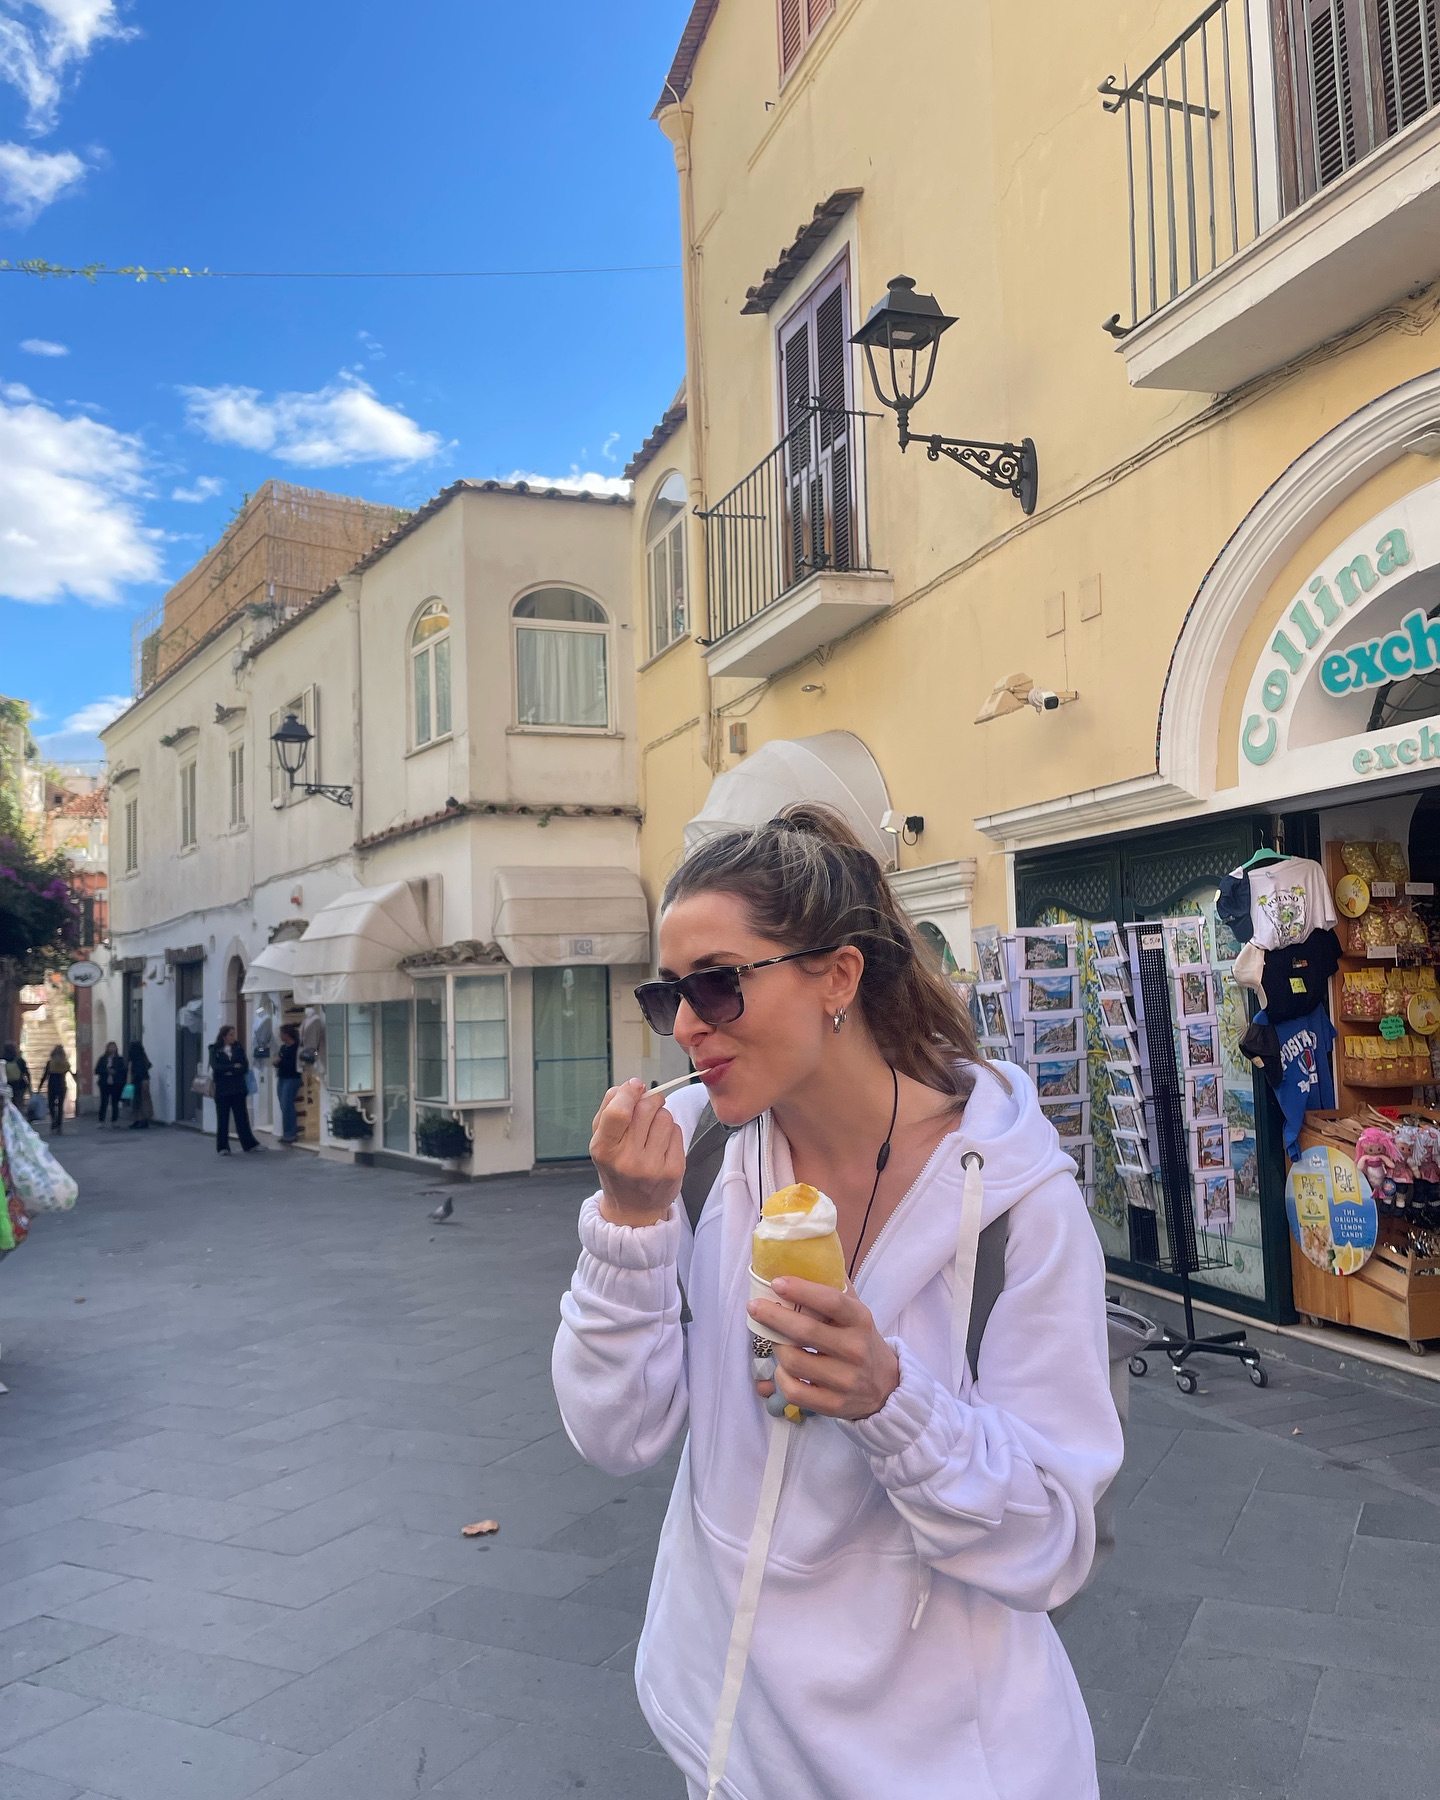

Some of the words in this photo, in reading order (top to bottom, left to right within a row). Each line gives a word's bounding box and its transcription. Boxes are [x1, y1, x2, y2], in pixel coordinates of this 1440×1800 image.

[1242, 528, 1412, 766] Collina
[1321, 612, 1440, 694] exch
[1352, 726, 1440, 774] exch
[1334, 1216, 1367, 1224] ORIGINAL
[1340, 1223, 1363, 1231] LEMON
[1341, 1231, 1363, 1239] CANDY
